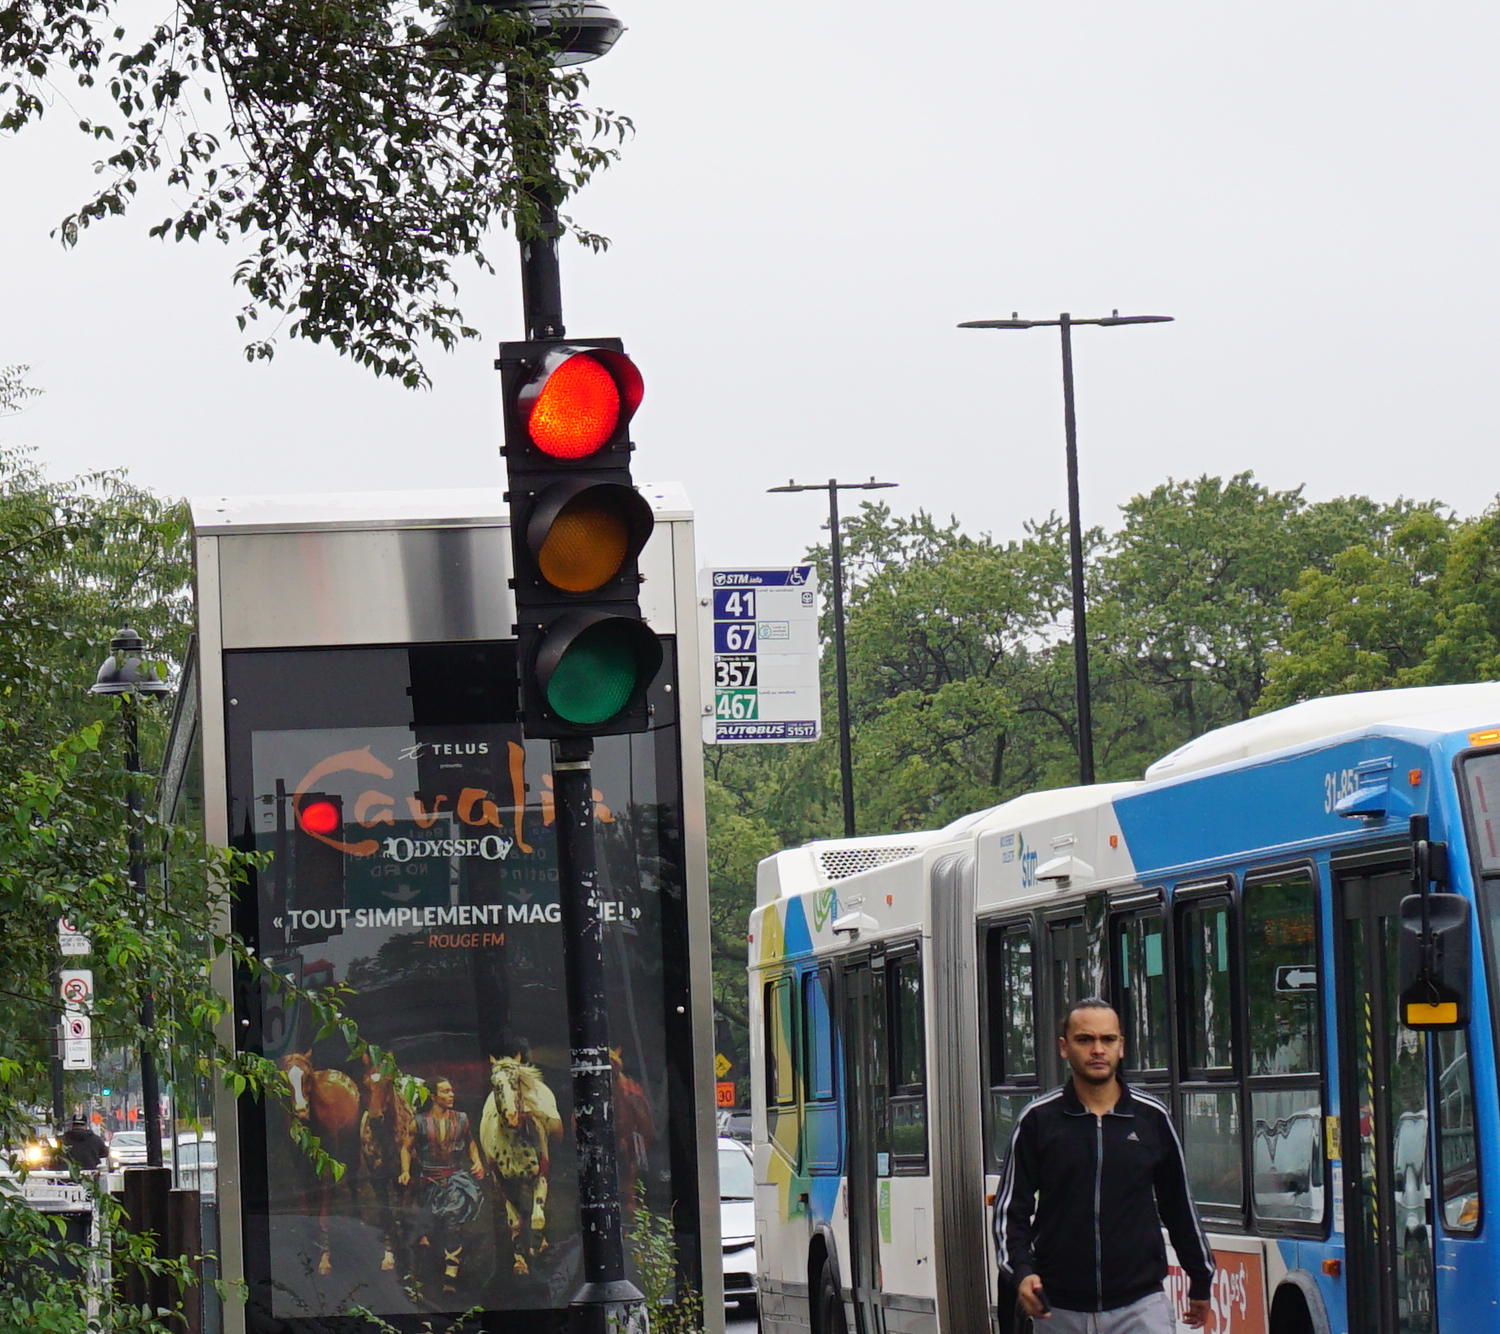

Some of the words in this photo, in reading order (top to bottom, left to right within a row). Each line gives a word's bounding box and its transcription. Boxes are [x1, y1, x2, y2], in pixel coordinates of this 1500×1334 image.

[724, 591, 755, 617] 41
[726, 624, 756, 650] 67
[715, 661, 756, 687] 357
[717, 693, 757, 719] 467
[716, 725, 785, 735] AUTOBUS
[431, 742, 489, 755] TELUS
[288, 908, 351, 929] TOUT
[355, 904, 503, 929] SIMPLEMENT
[428, 933, 479, 948] ROUGE
[482, 932, 505, 947] FM
[717, 1090, 732, 1102] 30
